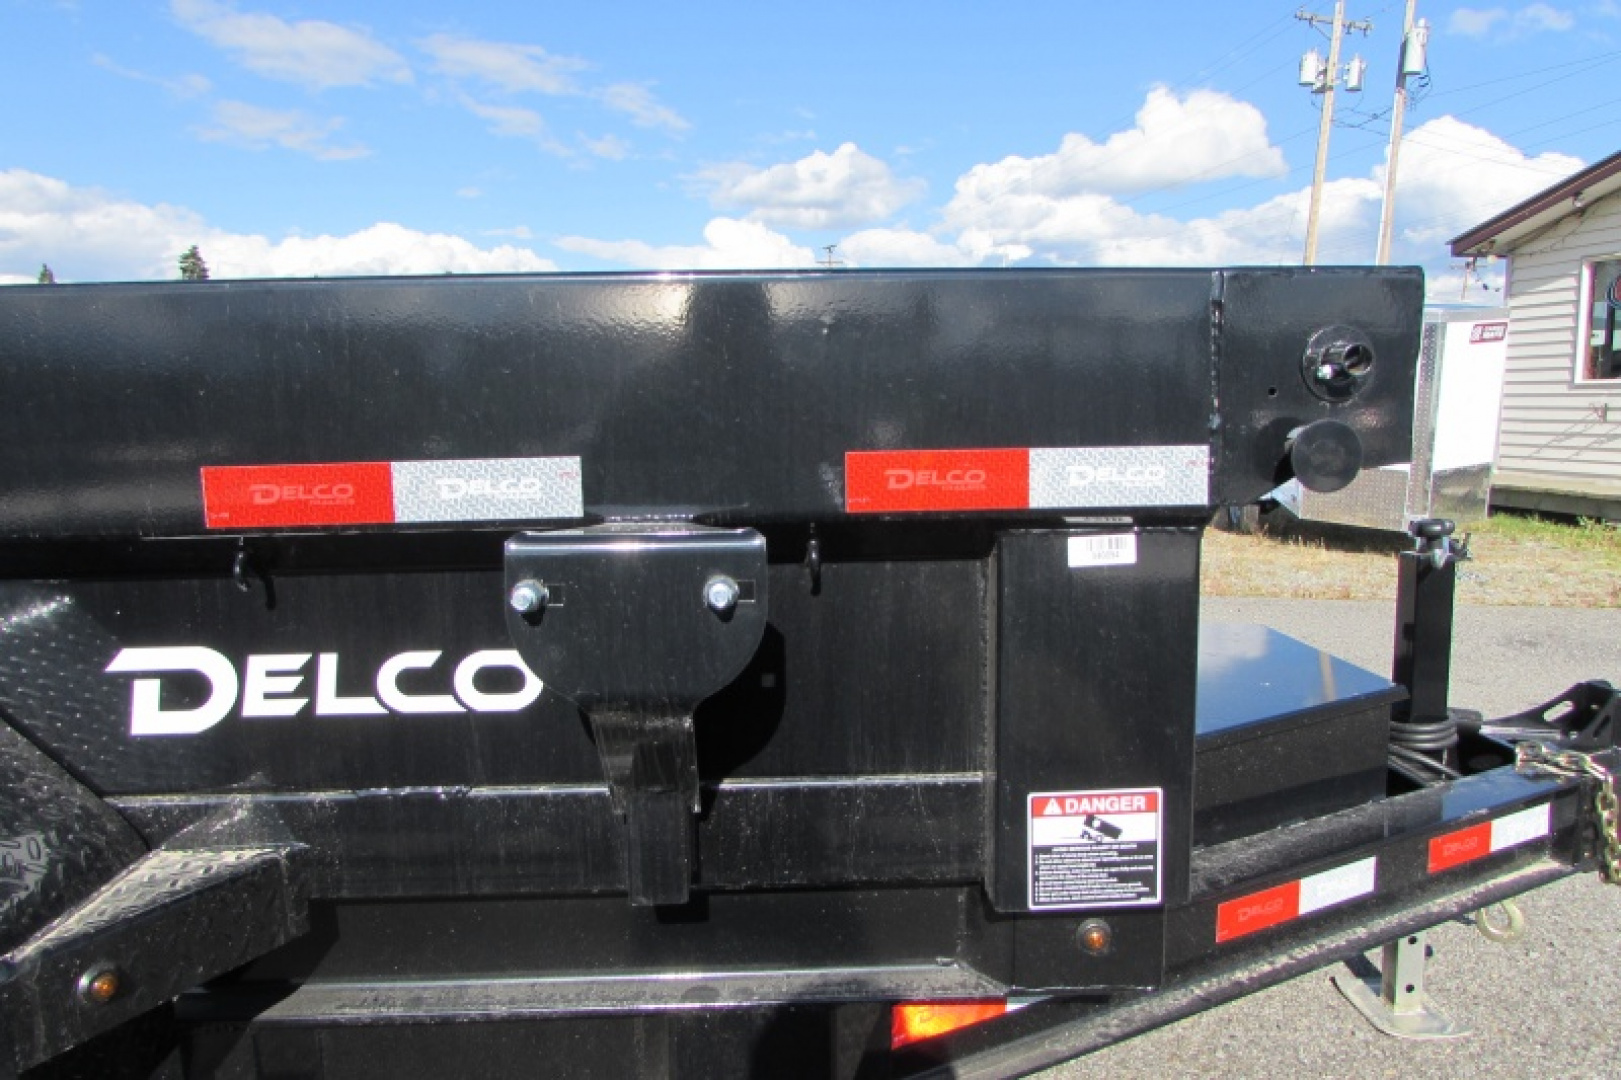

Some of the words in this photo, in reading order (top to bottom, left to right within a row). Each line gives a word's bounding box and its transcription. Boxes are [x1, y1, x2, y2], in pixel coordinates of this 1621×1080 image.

[883, 469, 986, 490] DELCO
[249, 483, 354, 505] DELCO
[104, 645, 543, 736] DELCO
[1065, 796, 1146, 813] DANGER
